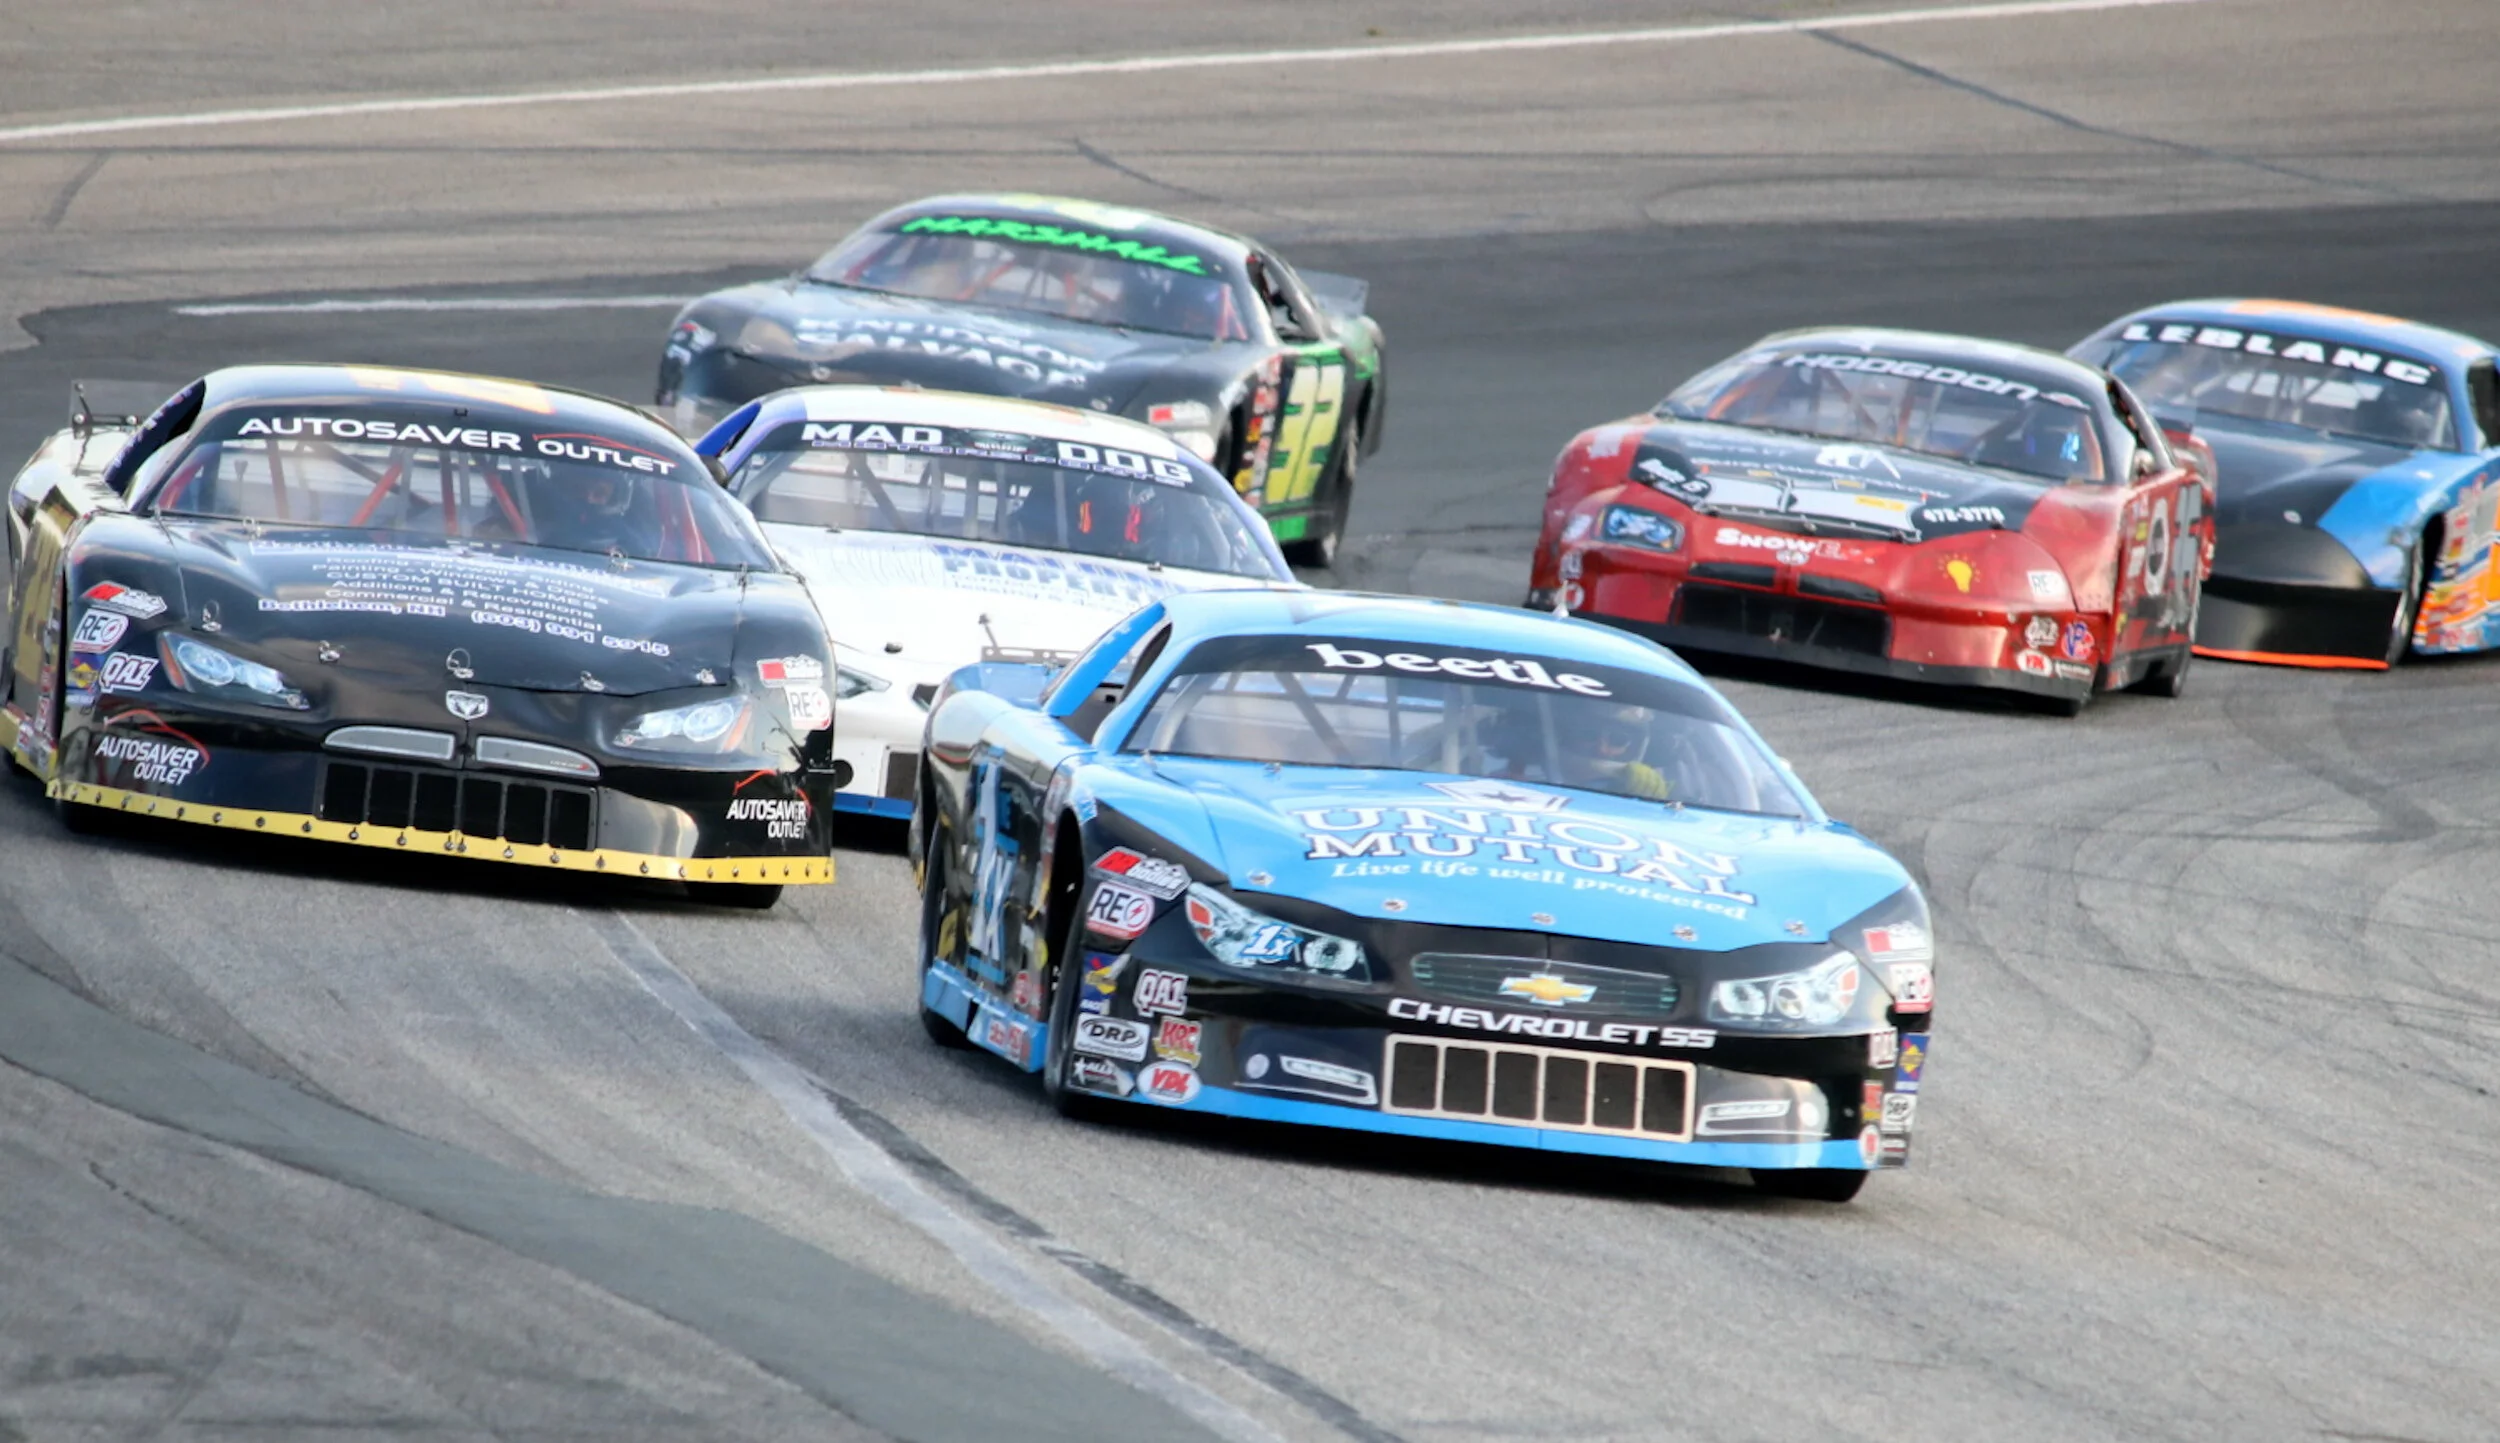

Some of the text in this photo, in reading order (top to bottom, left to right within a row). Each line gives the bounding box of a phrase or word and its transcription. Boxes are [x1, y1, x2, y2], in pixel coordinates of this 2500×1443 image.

[902, 216, 1207, 275] MARSHALL
[2122, 324, 2431, 385] LEBLANC
[238, 417, 676, 474] AUTOSAVER OUTLET
[801, 424, 1193, 483] MAD DOG
[312, 564, 400, 574] Painting
[420, 568, 517, 586] Windows
[547, 585, 608, 604] Doors
[326, 571, 597, 610] CUSTOM BUILT HOMES
[332, 580, 433, 593] Additions
[463, 589, 594, 619] Renovations
[325, 589, 454, 605] Commercial
[484, 602, 602, 631] Residential
[103, 655, 157, 692] QA1
[1305, 643, 1612, 697] beetle
[95, 736, 199, 768] AUTOSAVER
[133, 762, 190, 785] OUTLET
[768, 820, 806, 839] OUTLET
[1290, 807, 1740, 876] UNION
[1304, 831, 1758, 906] MUTUAL
[1331, 860, 1748, 921] Live life well protected
[1138, 970, 1185, 1012] QA1
[1090, 1024, 1137, 1042] DRP
[1387, 998, 1718, 1049] CHEVROLET SS
